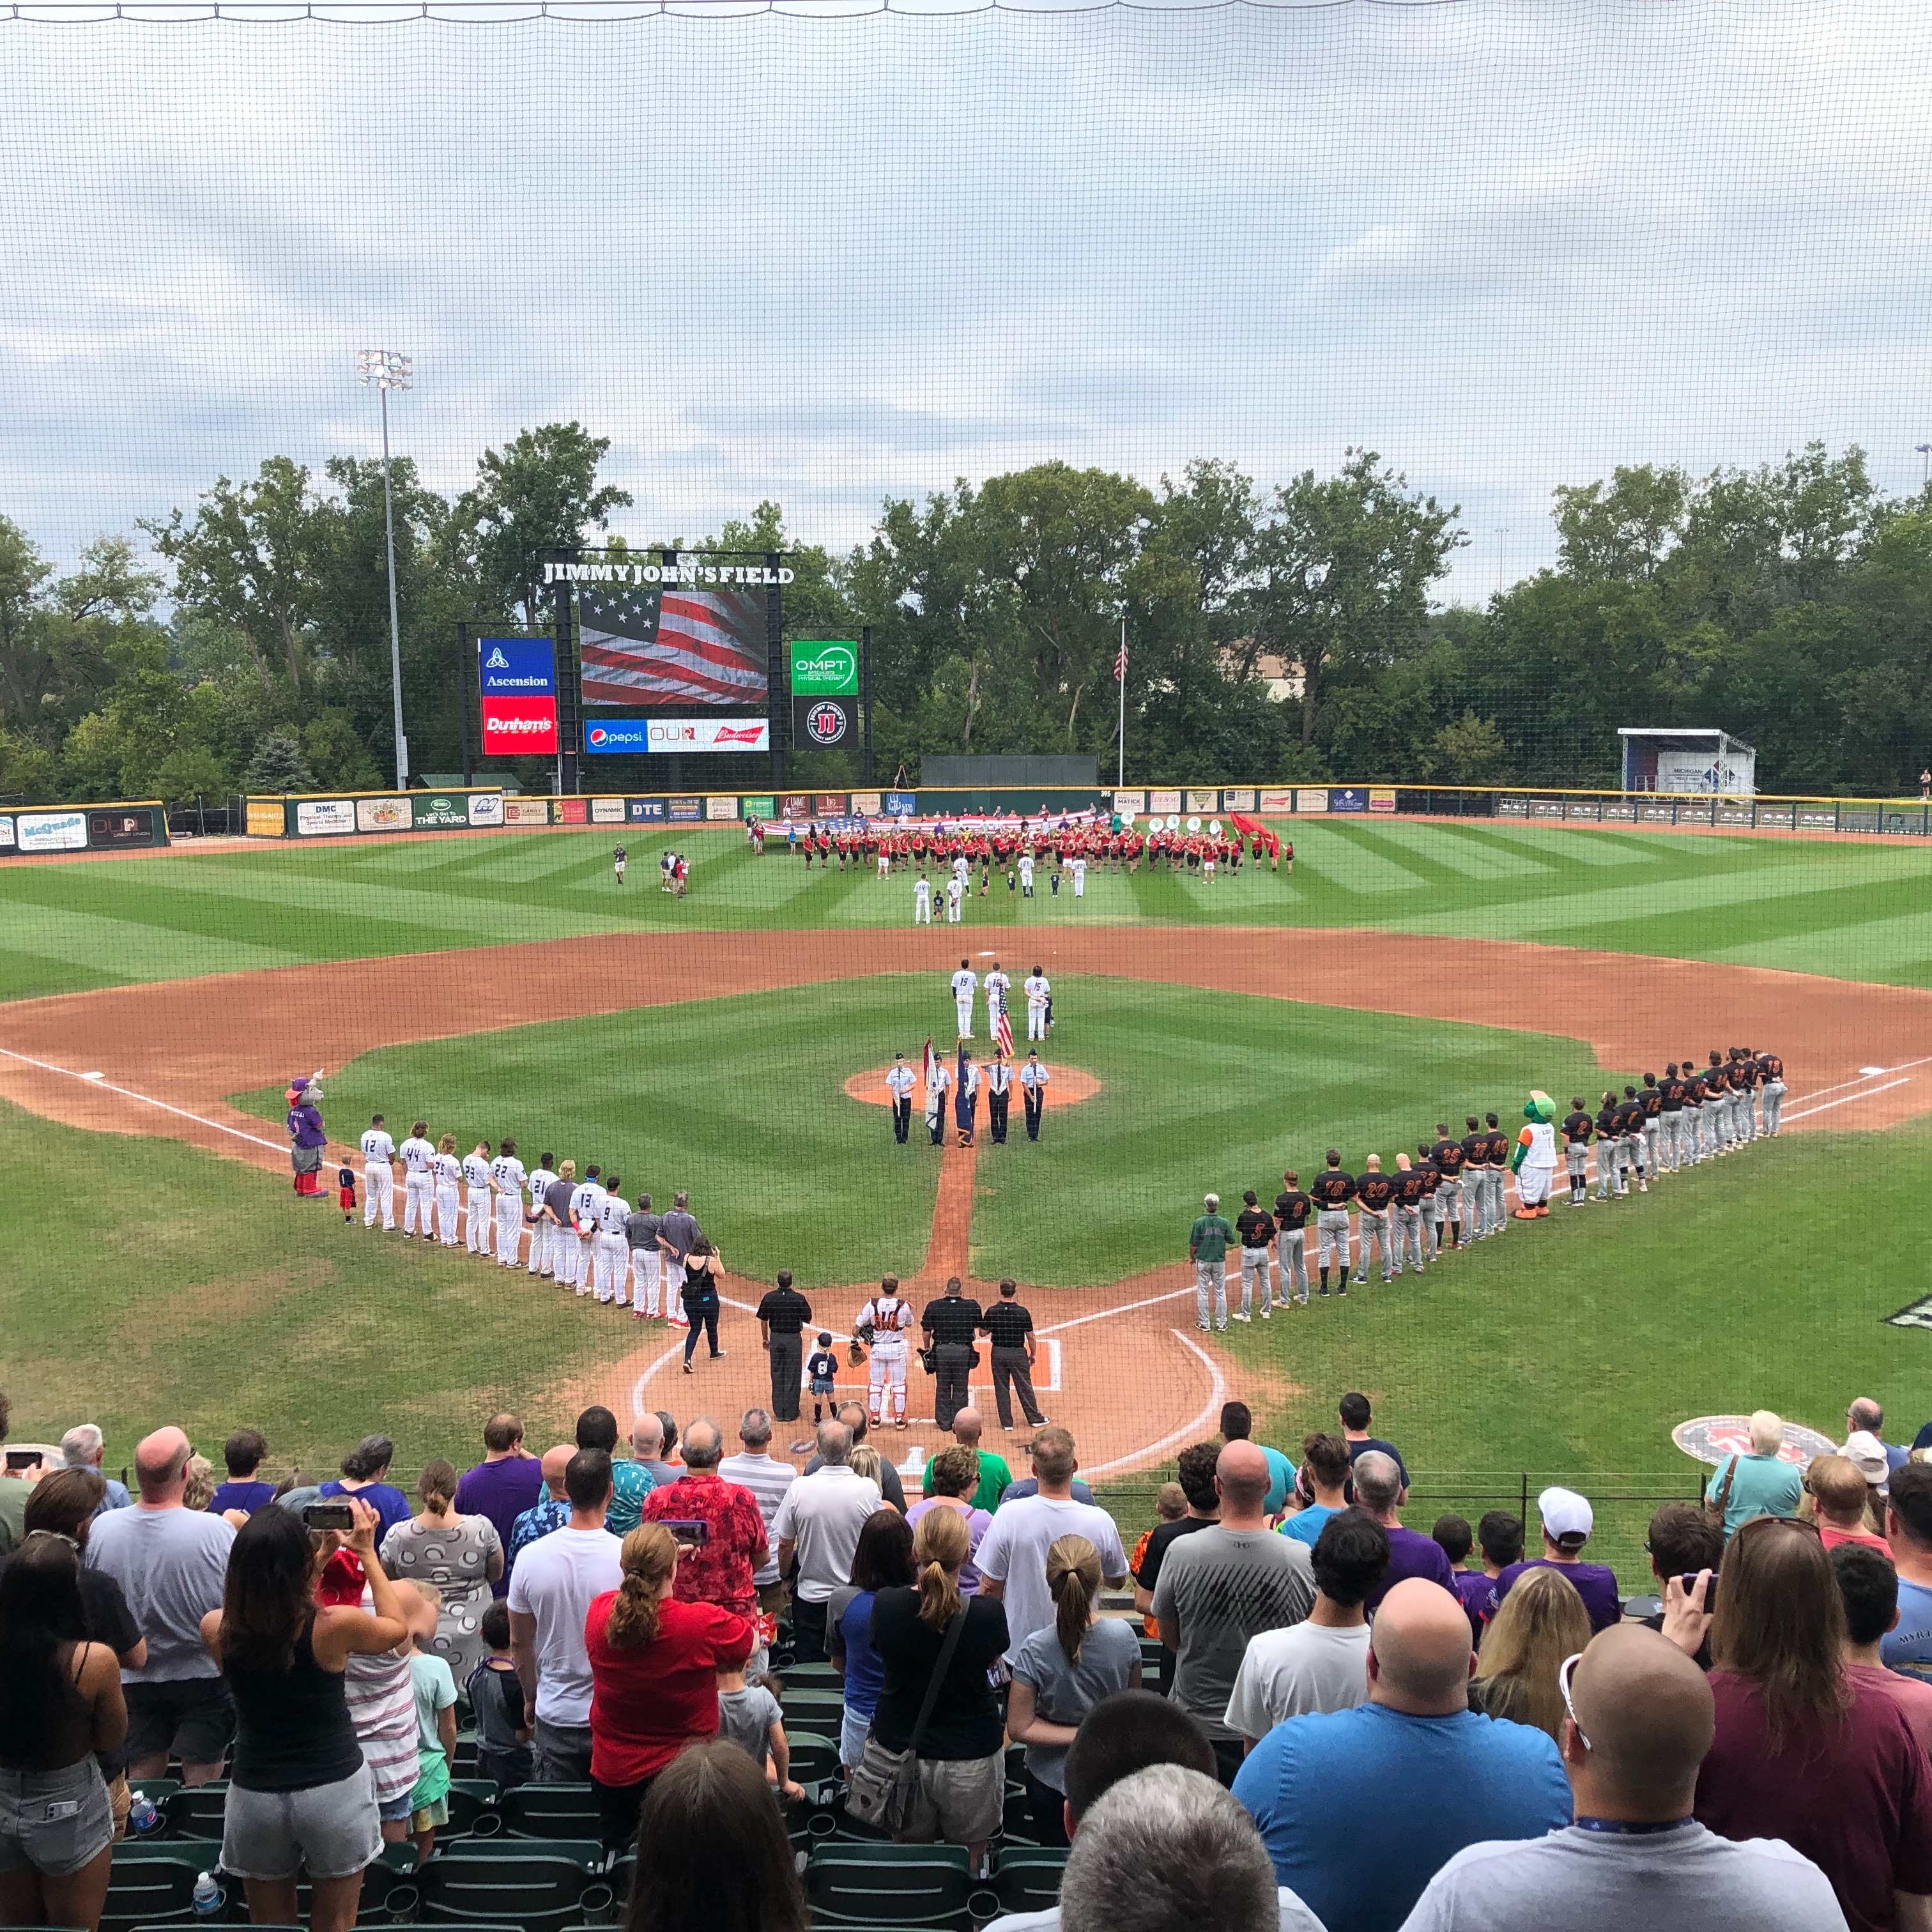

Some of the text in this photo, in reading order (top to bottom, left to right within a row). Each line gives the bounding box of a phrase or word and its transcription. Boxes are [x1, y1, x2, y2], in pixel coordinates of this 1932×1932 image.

[544, 563, 795, 585] JIMMY JOHN'S FIELD
[795, 660, 847, 671] OMPT
[486, 675, 548, 687] Ascension
[486, 716, 553, 732] Dunham's
[817, 713, 836, 734] JJ
[609, 731, 643, 746] pepsi
[316, 805, 337, 813] DMC
[632, 804, 663, 816] DTE
[438, 815, 466, 824] YARD
[960, 977, 969, 987] 19
[1034, 981, 1041, 992] 15
[1577, 1121, 1588, 1135] 2
[365, 1139, 376, 1153] 12
[406, 1147, 420, 1162] 44
[1443, 1148, 1461, 1164] 25
[434, 1162, 445, 1176] 25
[465, 1165, 475, 1179] 23
[495, 1163, 508, 1179] 22
[1325, 1181, 1346, 1196] 18
[1365, 1183, 1389, 1198] 20
[581, 1193, 593, 1208] 13
[603, 1207, 611, 1221] 9
[817, 1360, 828, 1375] 8
